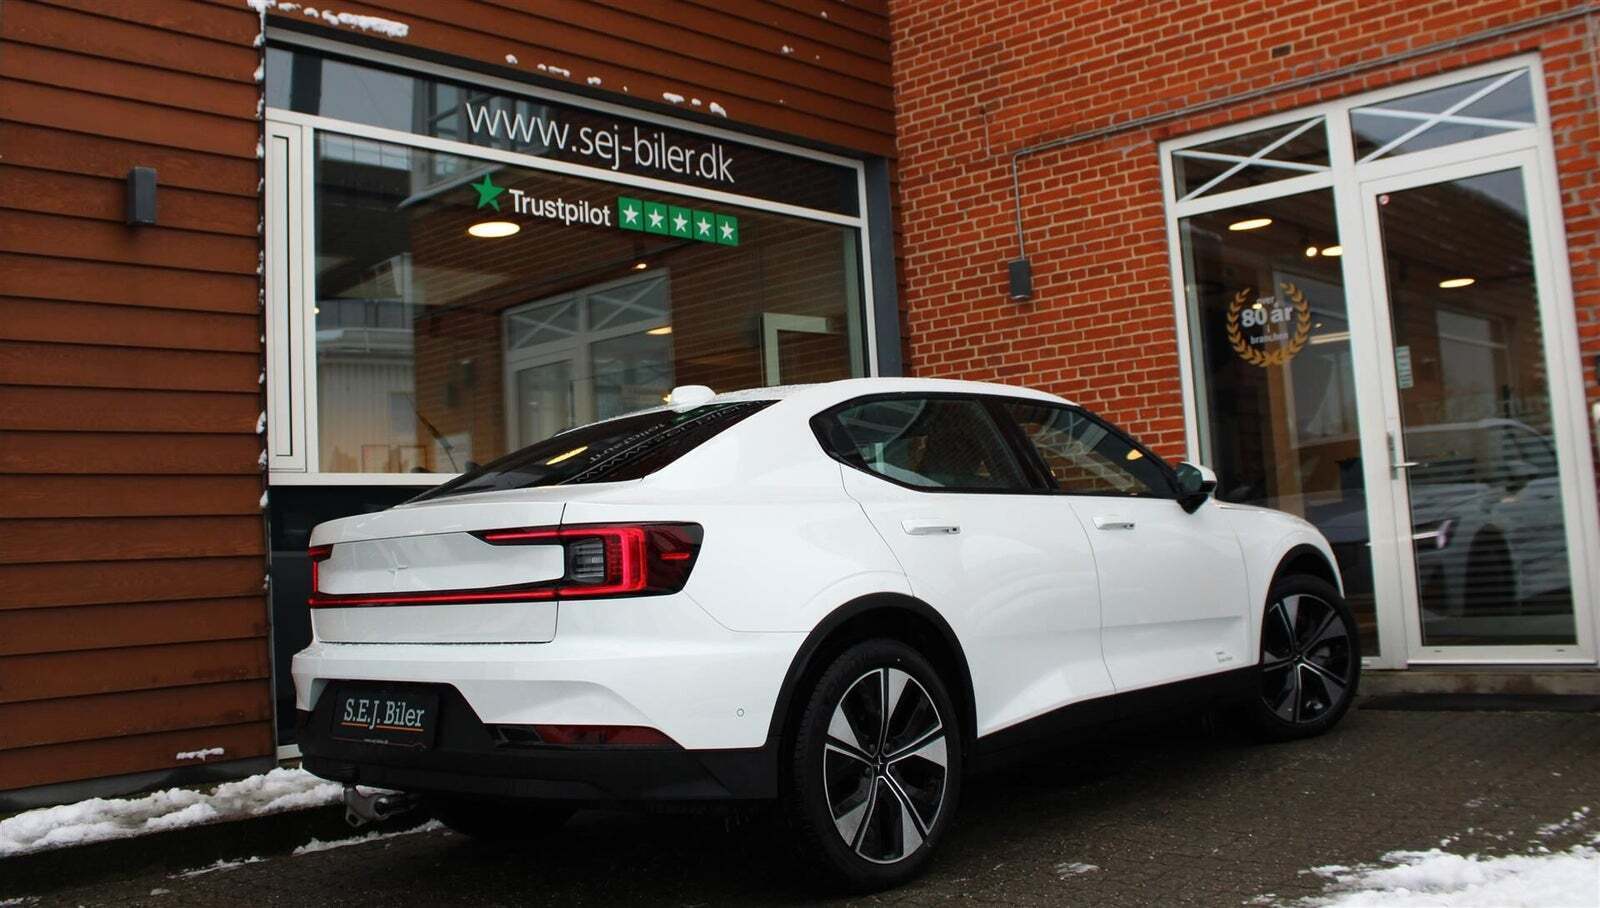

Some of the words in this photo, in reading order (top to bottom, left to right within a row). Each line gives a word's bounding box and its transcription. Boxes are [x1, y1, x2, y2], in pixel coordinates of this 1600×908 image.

[466, 102, 735, 183] www.sej-biler.dk
[508, 188, 611, 227] Trustpilot
[1241, 308, 1268, 327] 80
[1270, 302, 1293, 323] år
[343, 698, 380, 730] S.E.J.
[383, 701, 425, 728] Biler
